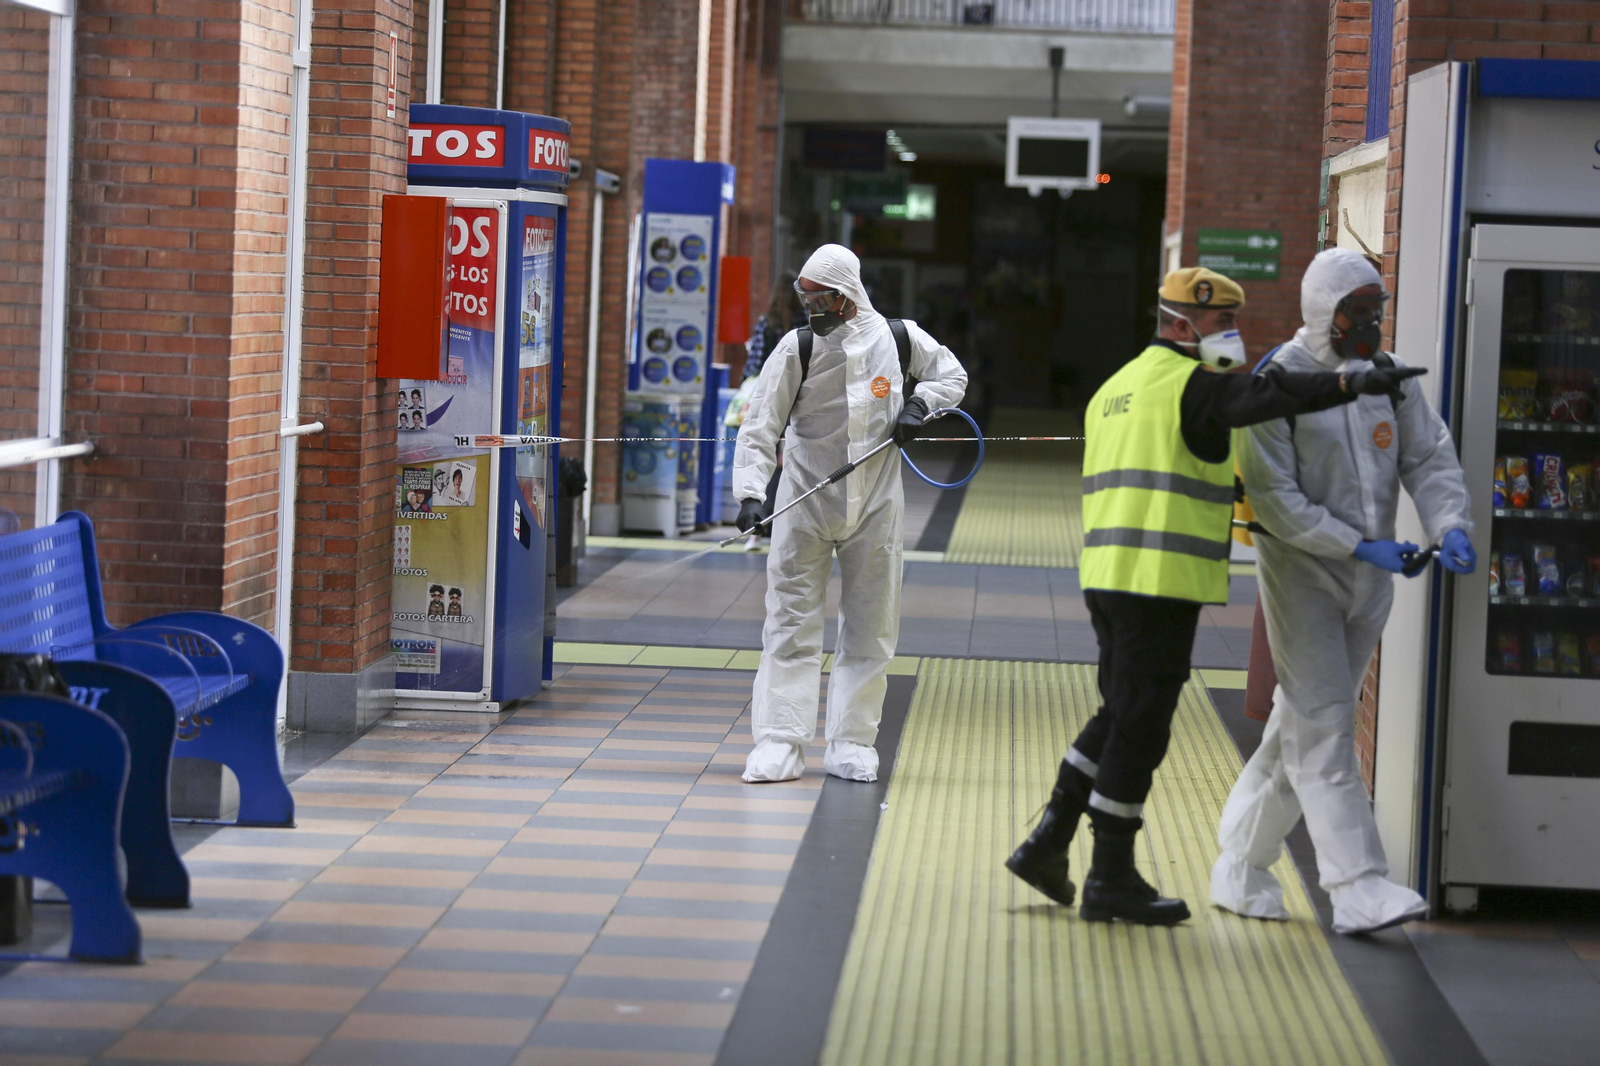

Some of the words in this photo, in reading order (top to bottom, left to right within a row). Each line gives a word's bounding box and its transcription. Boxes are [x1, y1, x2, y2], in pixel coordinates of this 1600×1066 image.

[408, 129, 497, 159] TOS
[451, 216, 490, 258] OS
[460, 265, 489, 284] LOS
[450, 291, 488, 317] TOS
[450, 327, 472, 337] MENTOS
[1103, 393, 1133, 418] UME
[396, 511, 448, 520] IVERTIDAS
[392, 567, 428, 577] IFOTOS
[393, 613, 425, 621] FOTOS
[428, 614, 474, 623] CARTERA
[391, 639, 436, 650] OTRON
